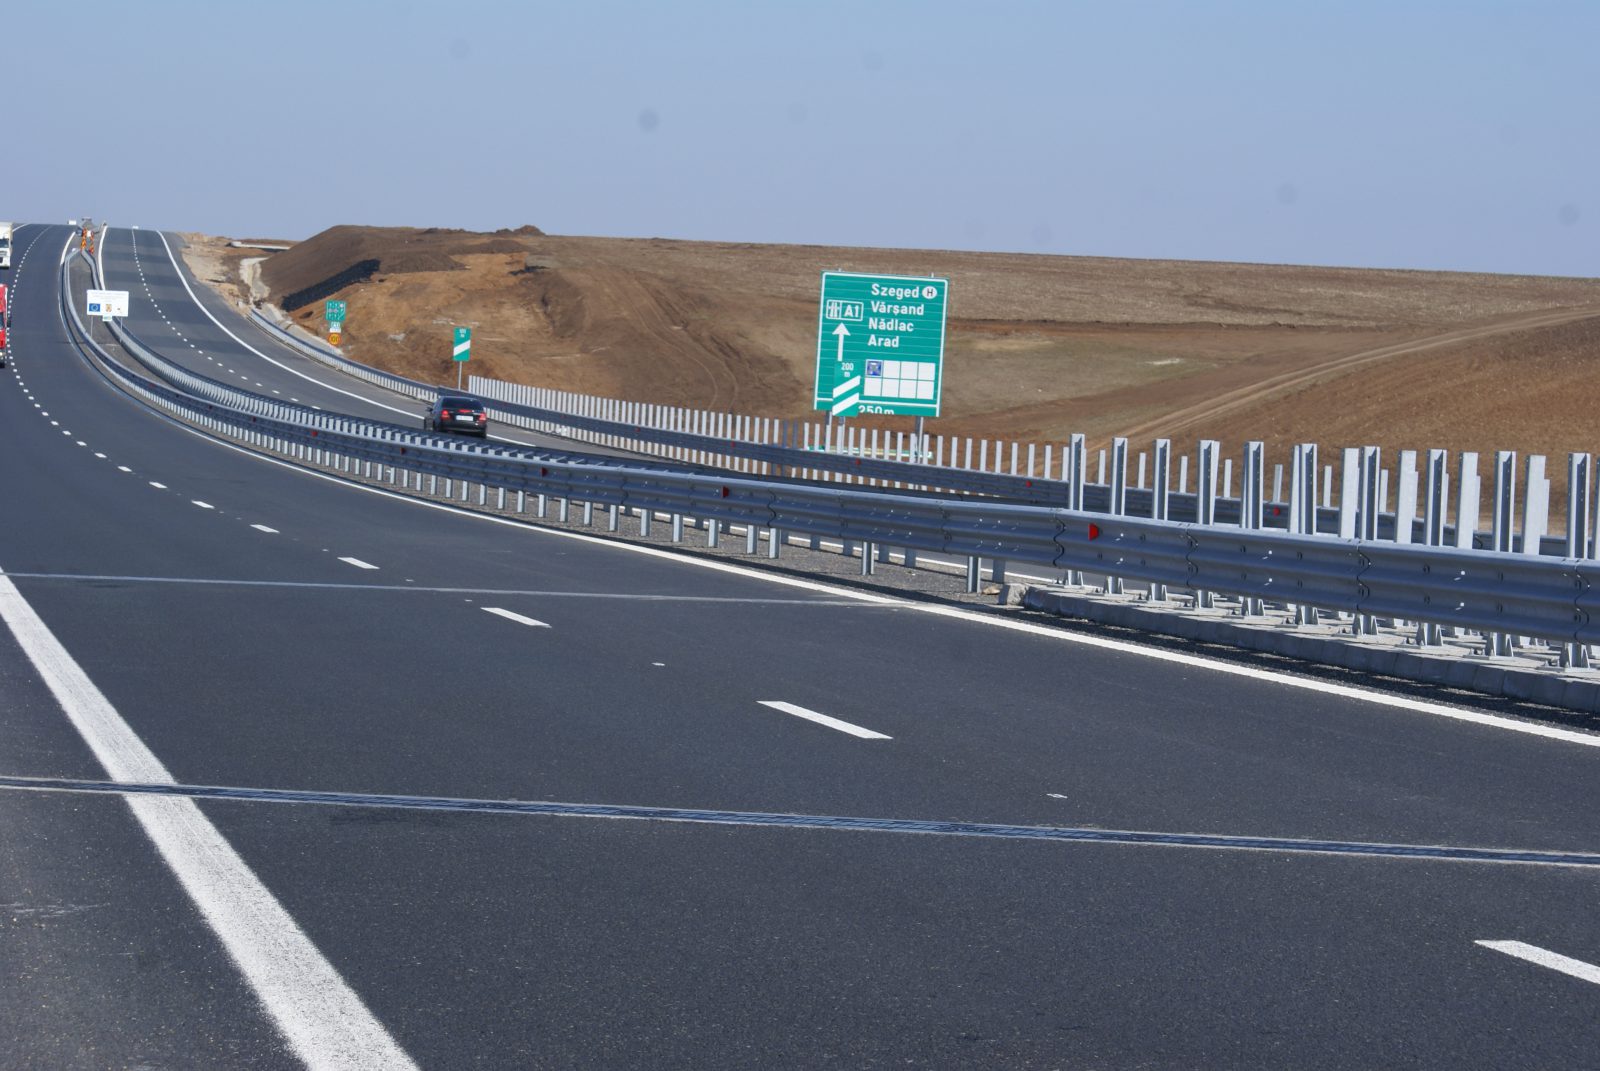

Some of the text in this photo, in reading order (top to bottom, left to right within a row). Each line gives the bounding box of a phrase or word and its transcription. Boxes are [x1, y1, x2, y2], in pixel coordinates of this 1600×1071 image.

[871, 283, 920, 300] Szeged
[844, 306, 859, 318] A1
[868, 317, 914, 332] Nădlac
[867, 334, 900, 348] Arad
[841, 362, 854, 371] 200
